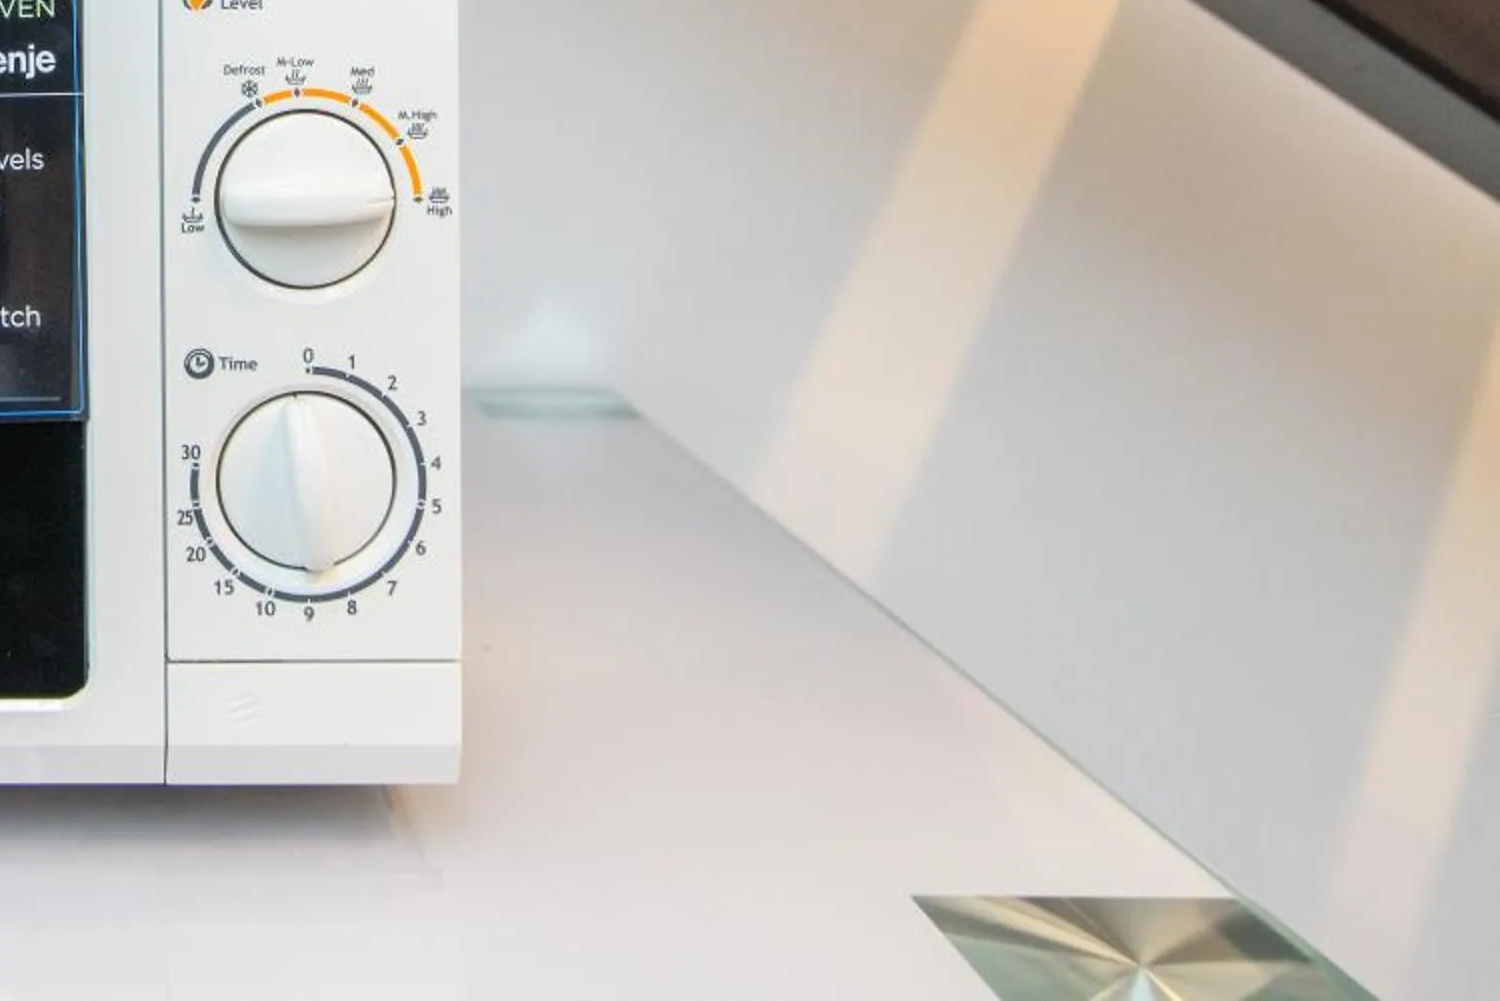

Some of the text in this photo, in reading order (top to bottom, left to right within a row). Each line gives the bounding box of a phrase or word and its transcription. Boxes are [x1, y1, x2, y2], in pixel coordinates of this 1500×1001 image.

[223, 65, 265, 76] Defrost
[350, 66, 374, 78] Med
[427, 206, 453, 217] High
[181, 222, 204, 233] Low
[303, 349, 315, 363] 0
[348, 356, 356, 369] 1
[219, 356, 258, 372] Time
[388, 376, 398, 391] 2
[417, 412, 427, 426] 3
[181, 444, 201, 459] 30
[431, 456, 441, 470] 4
[432, 499, 442, 513] 5
[177, 510, 194, 525] 25
[186, 547, 206, 562] 20
[416, 542, 427, 556] 6
[214, 580, 234, 595] 15
[387, 581, 397, 596] 7
[257, 601, 276, 616] 10
[304, 607, 315, 621] 9
[347, 601, 357, 615] 8
